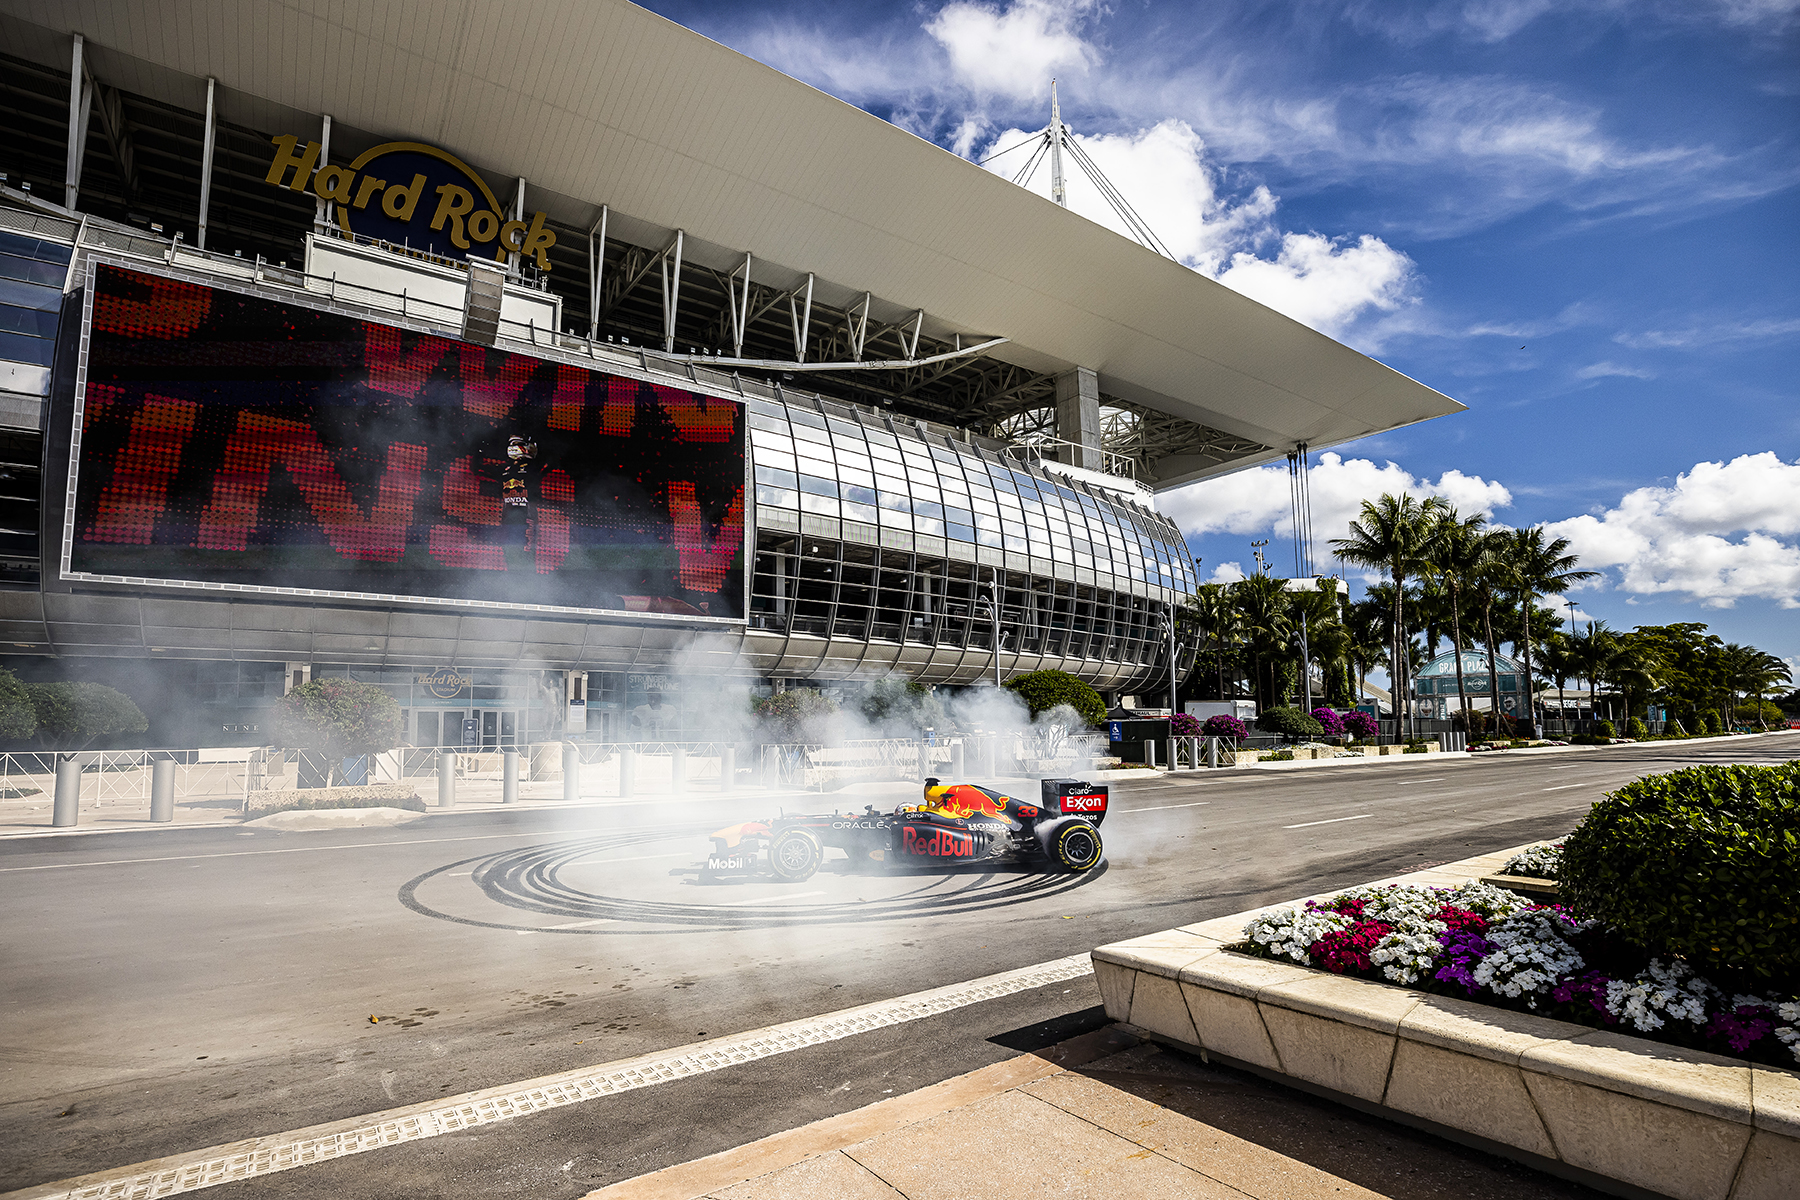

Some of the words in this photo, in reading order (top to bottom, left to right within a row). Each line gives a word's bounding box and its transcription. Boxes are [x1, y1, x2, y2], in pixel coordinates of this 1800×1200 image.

[265, 134, 427, 222] Hard
[429, 183, 557, 271] Rock
[418, 674, 447, 685] Hard
[447, 674, 472, 687] Rock
[628, 675, 667, 684] STRONGER
[643, 682, 663, 690] THAN
[664, 682, 679, 690] ONE
[1066, 796, 1102, 811] Exxon
[1018, 806, 1038, 817] 33
[832, 821, 885, 830] ORACLE
[967, 823, 1010, 832] HONDA
[708, 857, 743, 870] Mobil
